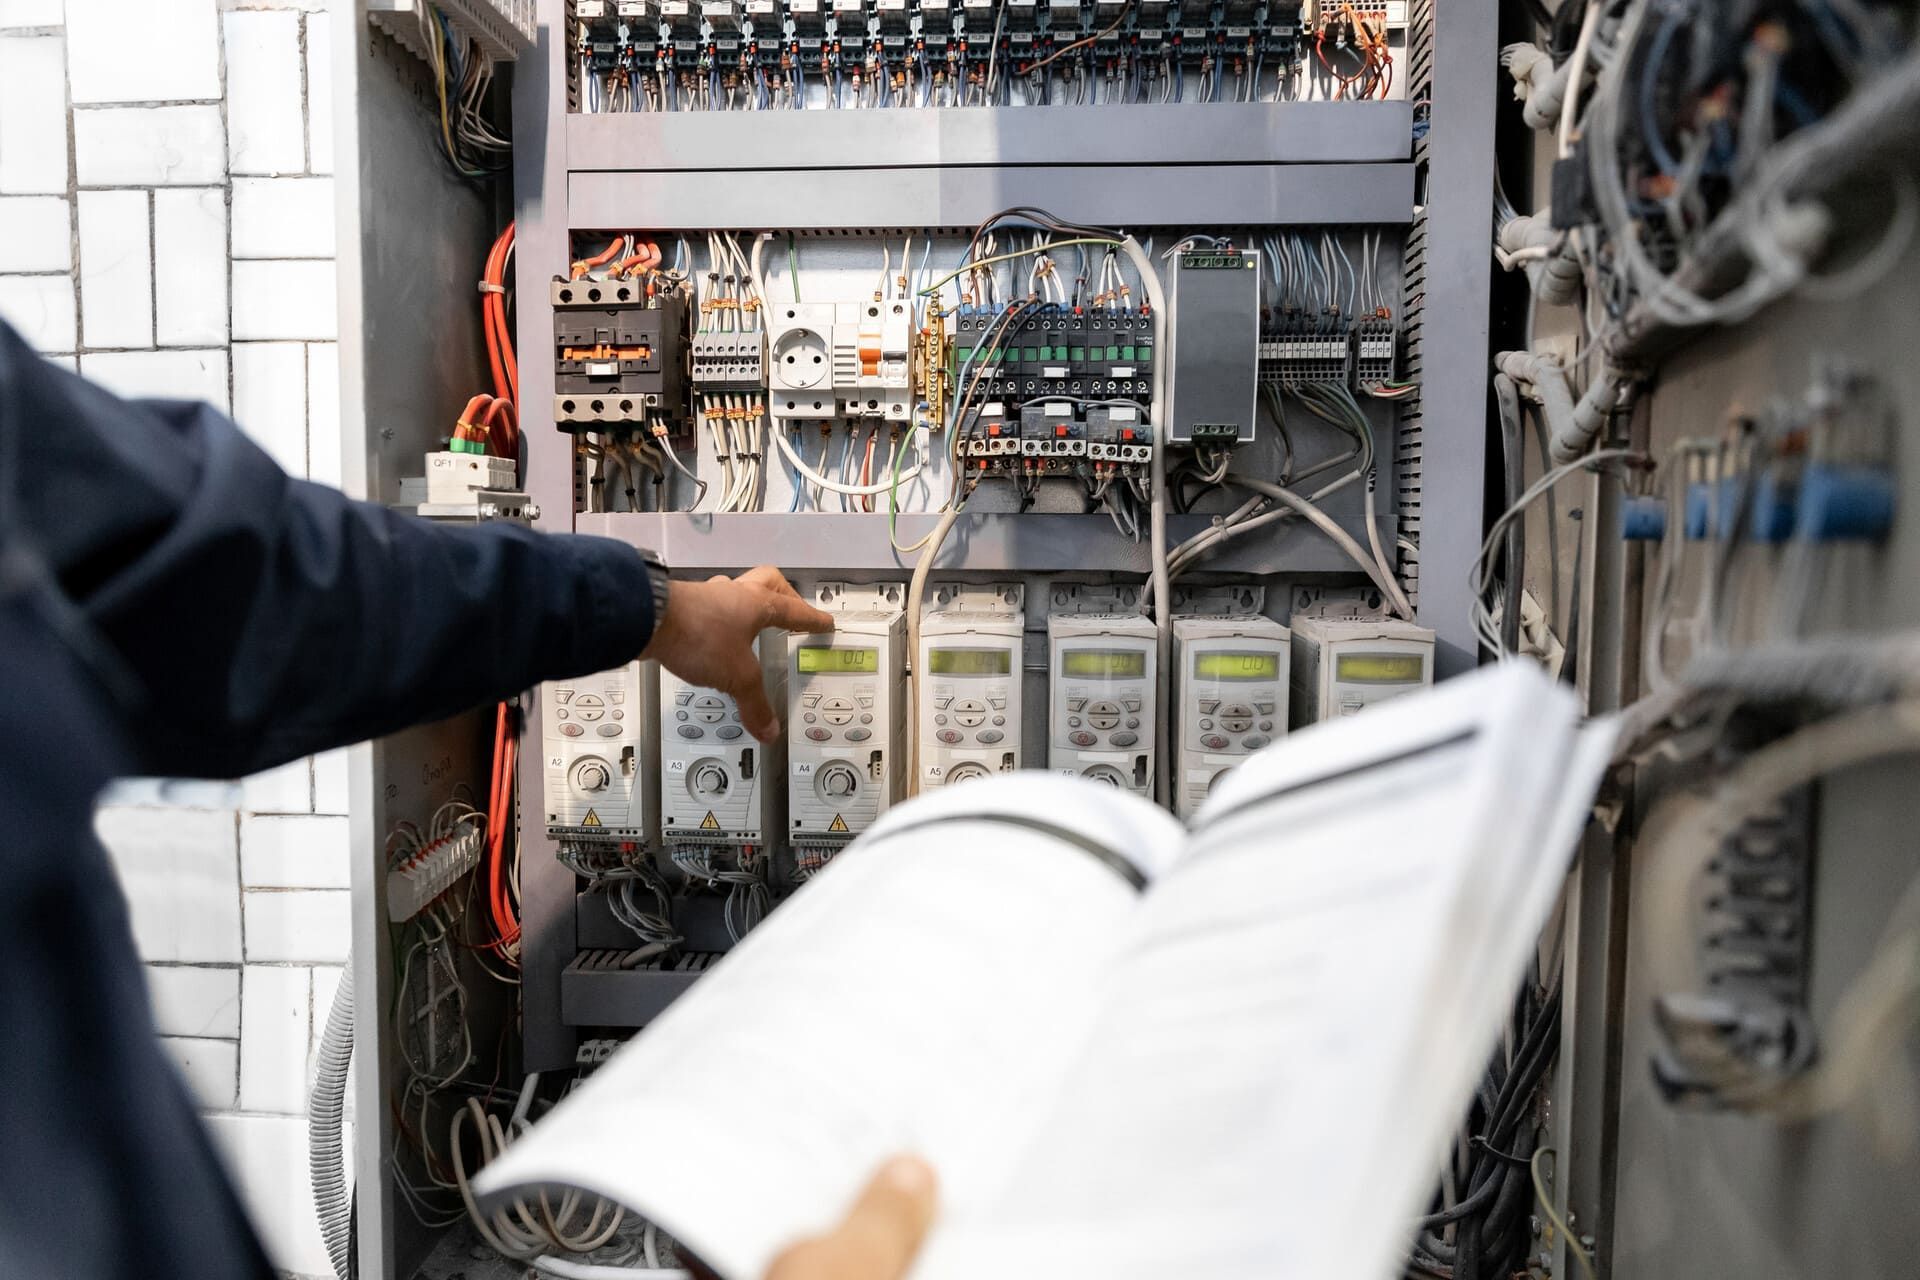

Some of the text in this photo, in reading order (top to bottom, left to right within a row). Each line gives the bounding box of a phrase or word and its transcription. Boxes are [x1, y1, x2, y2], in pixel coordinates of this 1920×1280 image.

[551, 758, 563, 766] A2
[671, 761, 683, 770] A3
[799, 765, 811, 773] A4
[929, 768, 942, 776] A5
